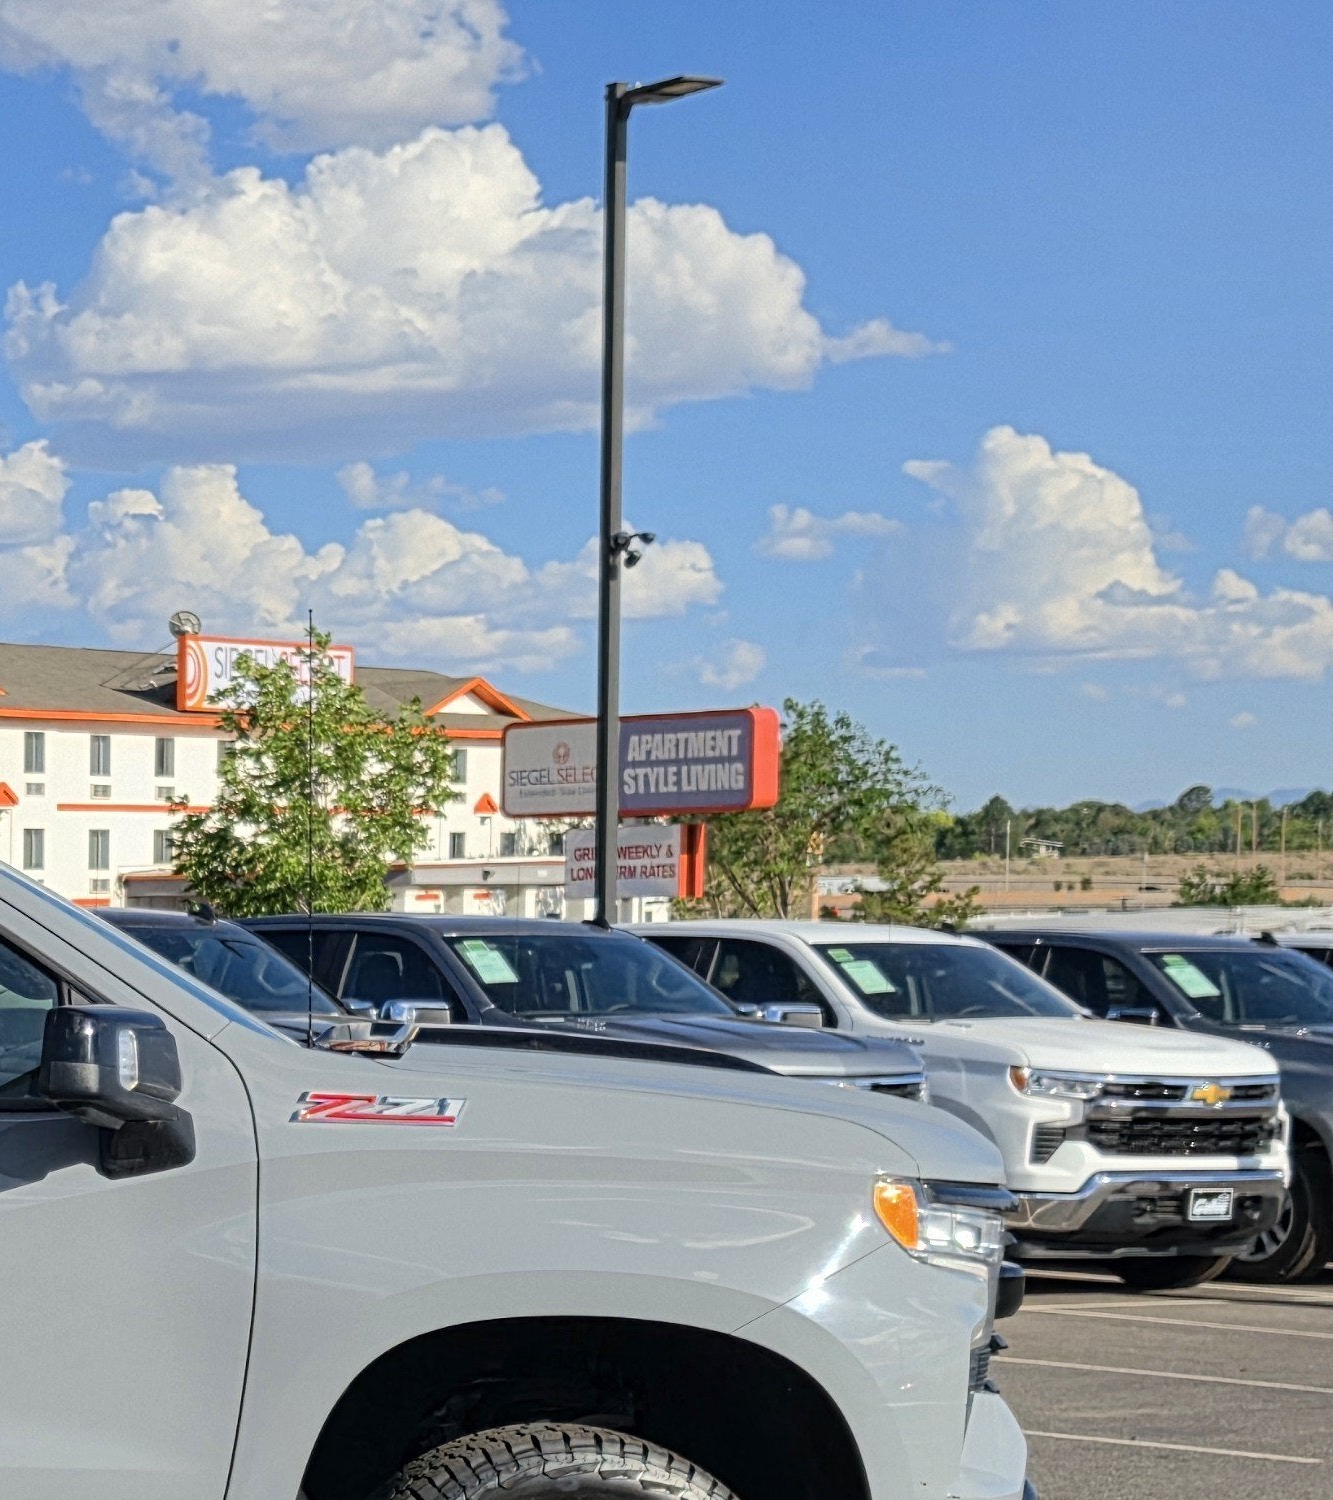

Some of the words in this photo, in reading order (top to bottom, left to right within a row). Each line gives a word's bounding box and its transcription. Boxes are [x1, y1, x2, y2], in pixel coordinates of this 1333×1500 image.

[627, 730, 741, 762] APARTMENT
[509, 768, 551, 786] SIEGEL
[557, 766, 596, 785] SELEC
[623, 766, 678, 794] STYLE
[681, 762, 745, 792] LIVING
[617, 844, 662, 860] WEEKLY
[666, 844, 673, 858] &
[571, 867, 596, 881] LON
[640, 864, 676, 878] RATES
[288, 1090, 467, 1128] Z71
